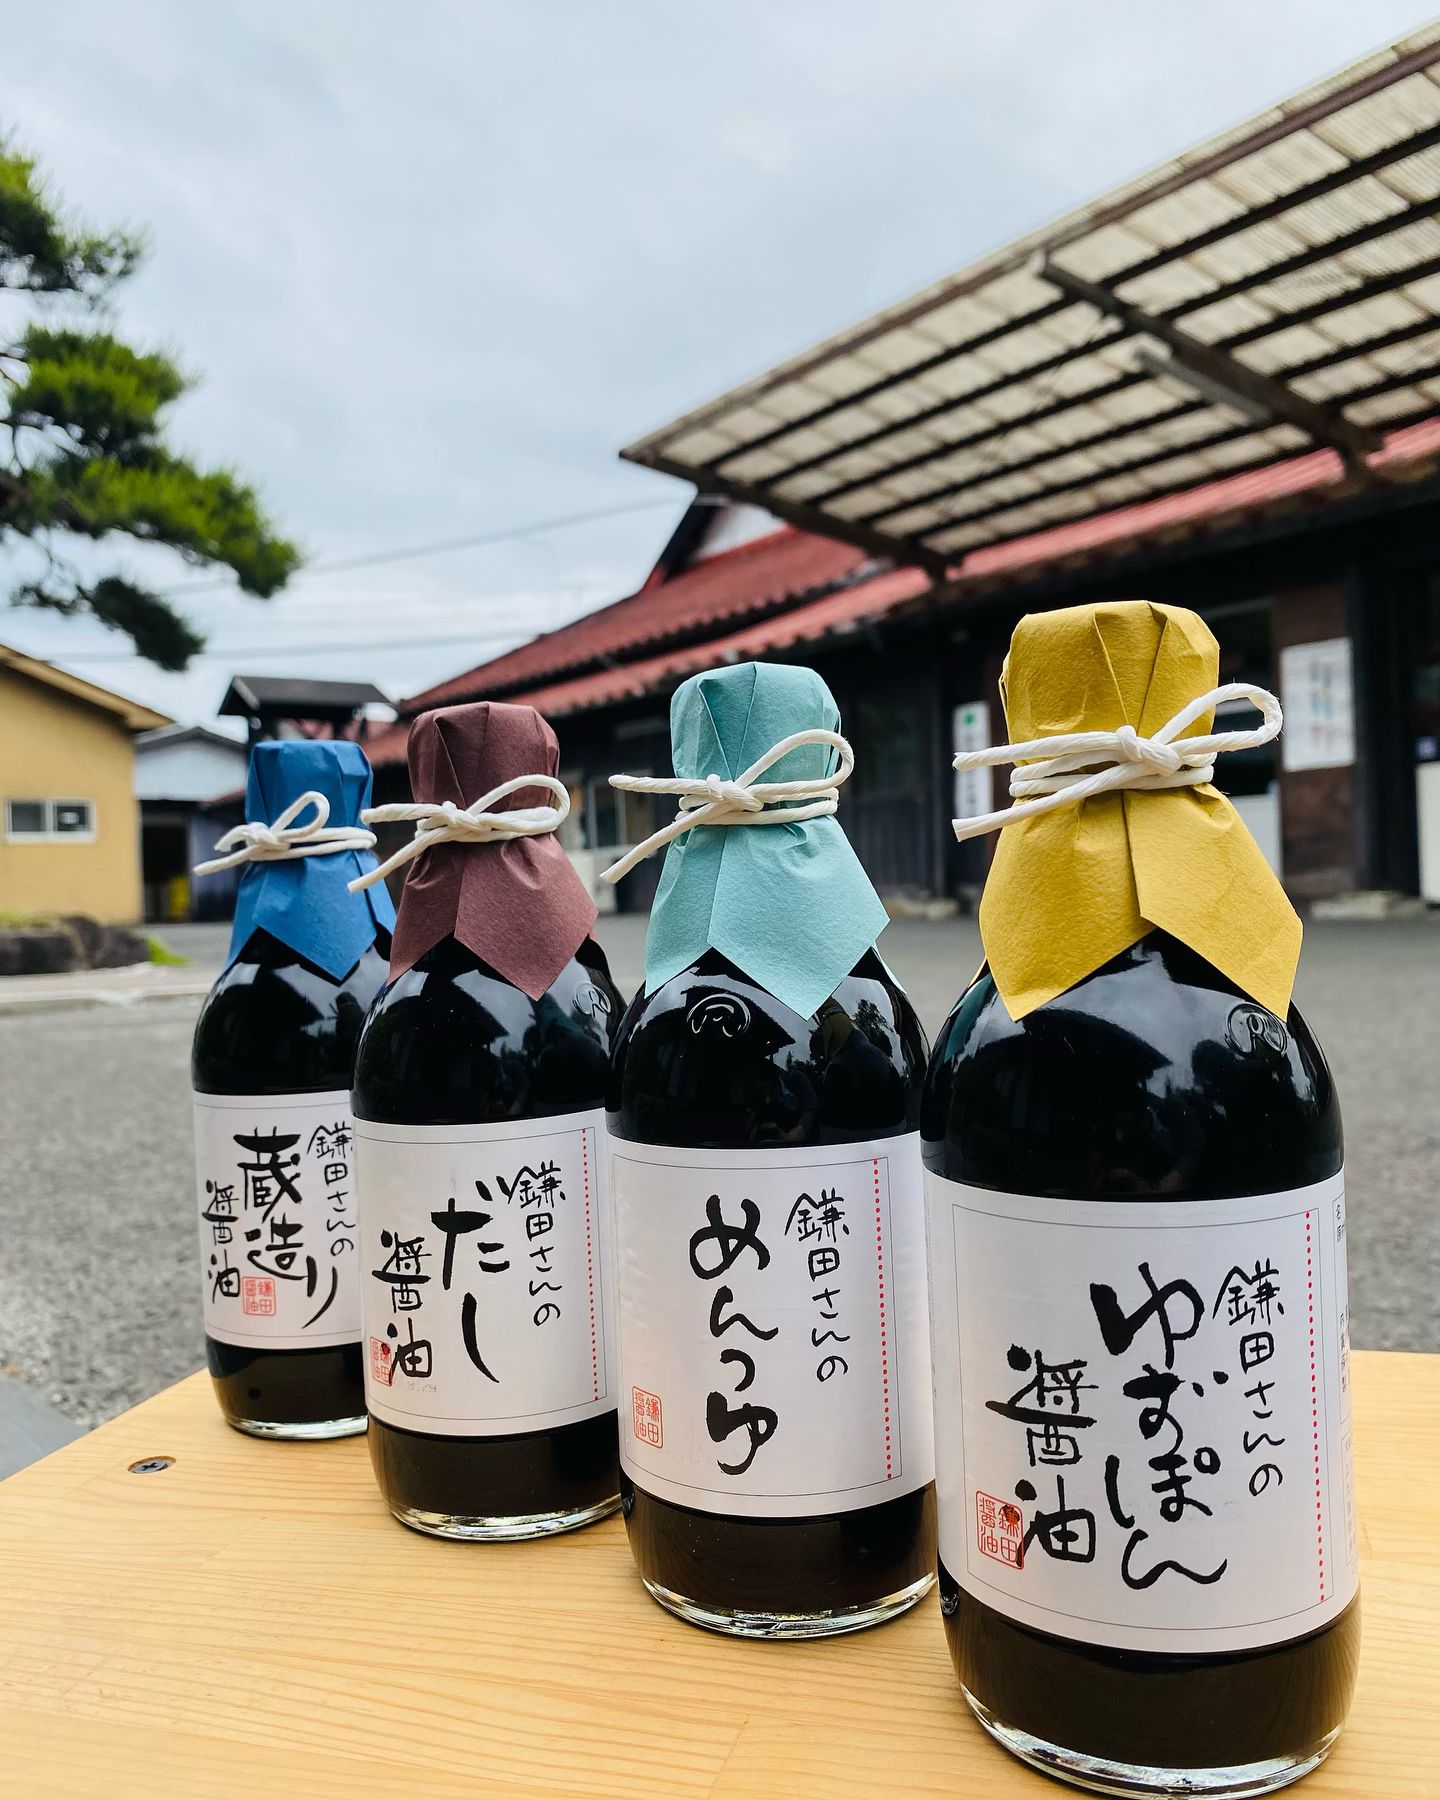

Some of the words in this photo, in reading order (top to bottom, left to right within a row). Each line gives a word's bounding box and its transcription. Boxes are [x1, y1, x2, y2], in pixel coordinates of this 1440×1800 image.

[202, 1179, 241, 1304] 醤油
[232, 1125, 338, 1329] 蔵造り
[306, 1121, 356, 1257] 鎌田さんの
[430, 1175, 511, 1384] だし
[507, 1160, 567, 1327] 鎌田さんの
[784, 1187, 851, 1383] 鎌田さんの
[371, 1230, 433, 1386] 醤油
[689, 1194, 779, 1476] めんつゆ
[1212, 1257, 1286, 1497] 鎌田さんの
[985, 1343, 1100, 1567] 醤油
[1090, 1261, 1230, 1590] ゆずぽん
